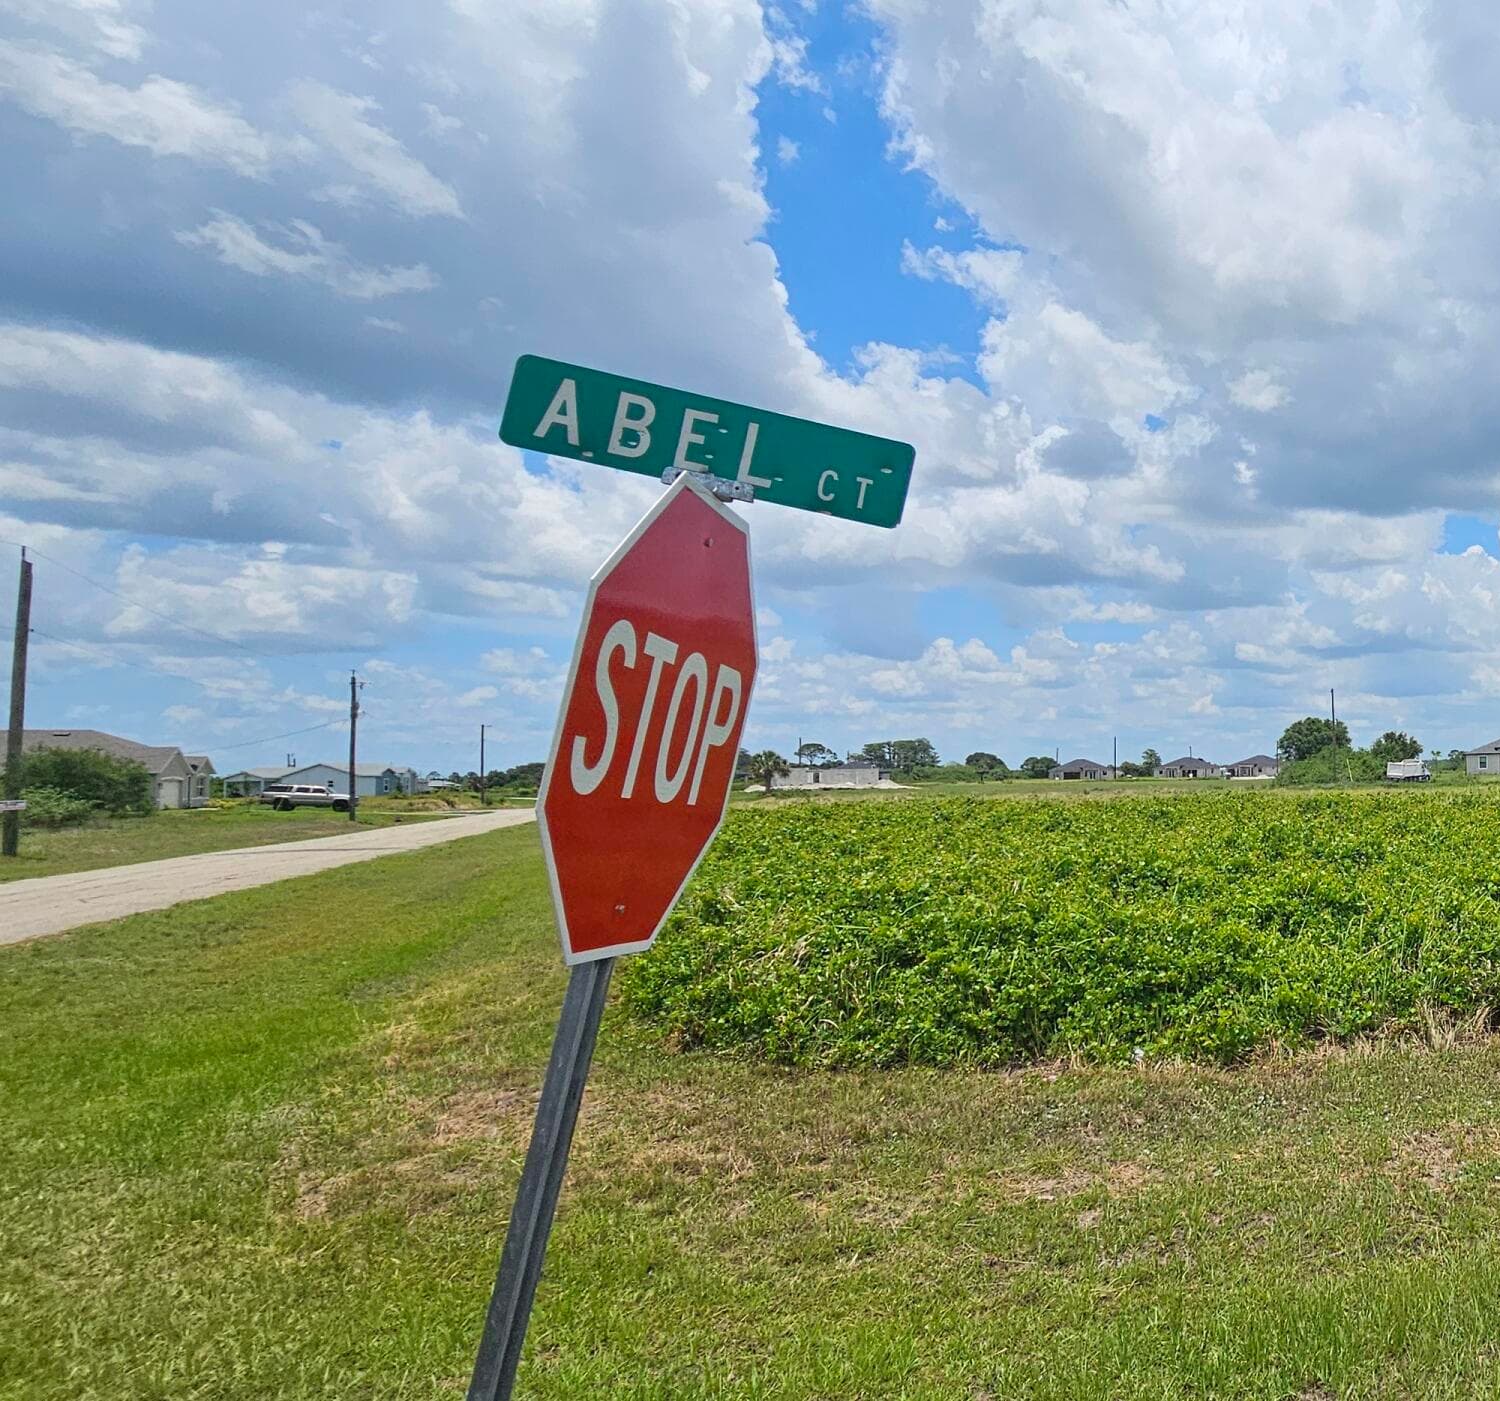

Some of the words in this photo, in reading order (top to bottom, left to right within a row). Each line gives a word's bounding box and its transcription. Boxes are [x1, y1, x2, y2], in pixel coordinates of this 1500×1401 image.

[534, 379, 772, 488] ABEL
[818, 470, 874, 509] CT
[570, 619, 742, 805] STOP
